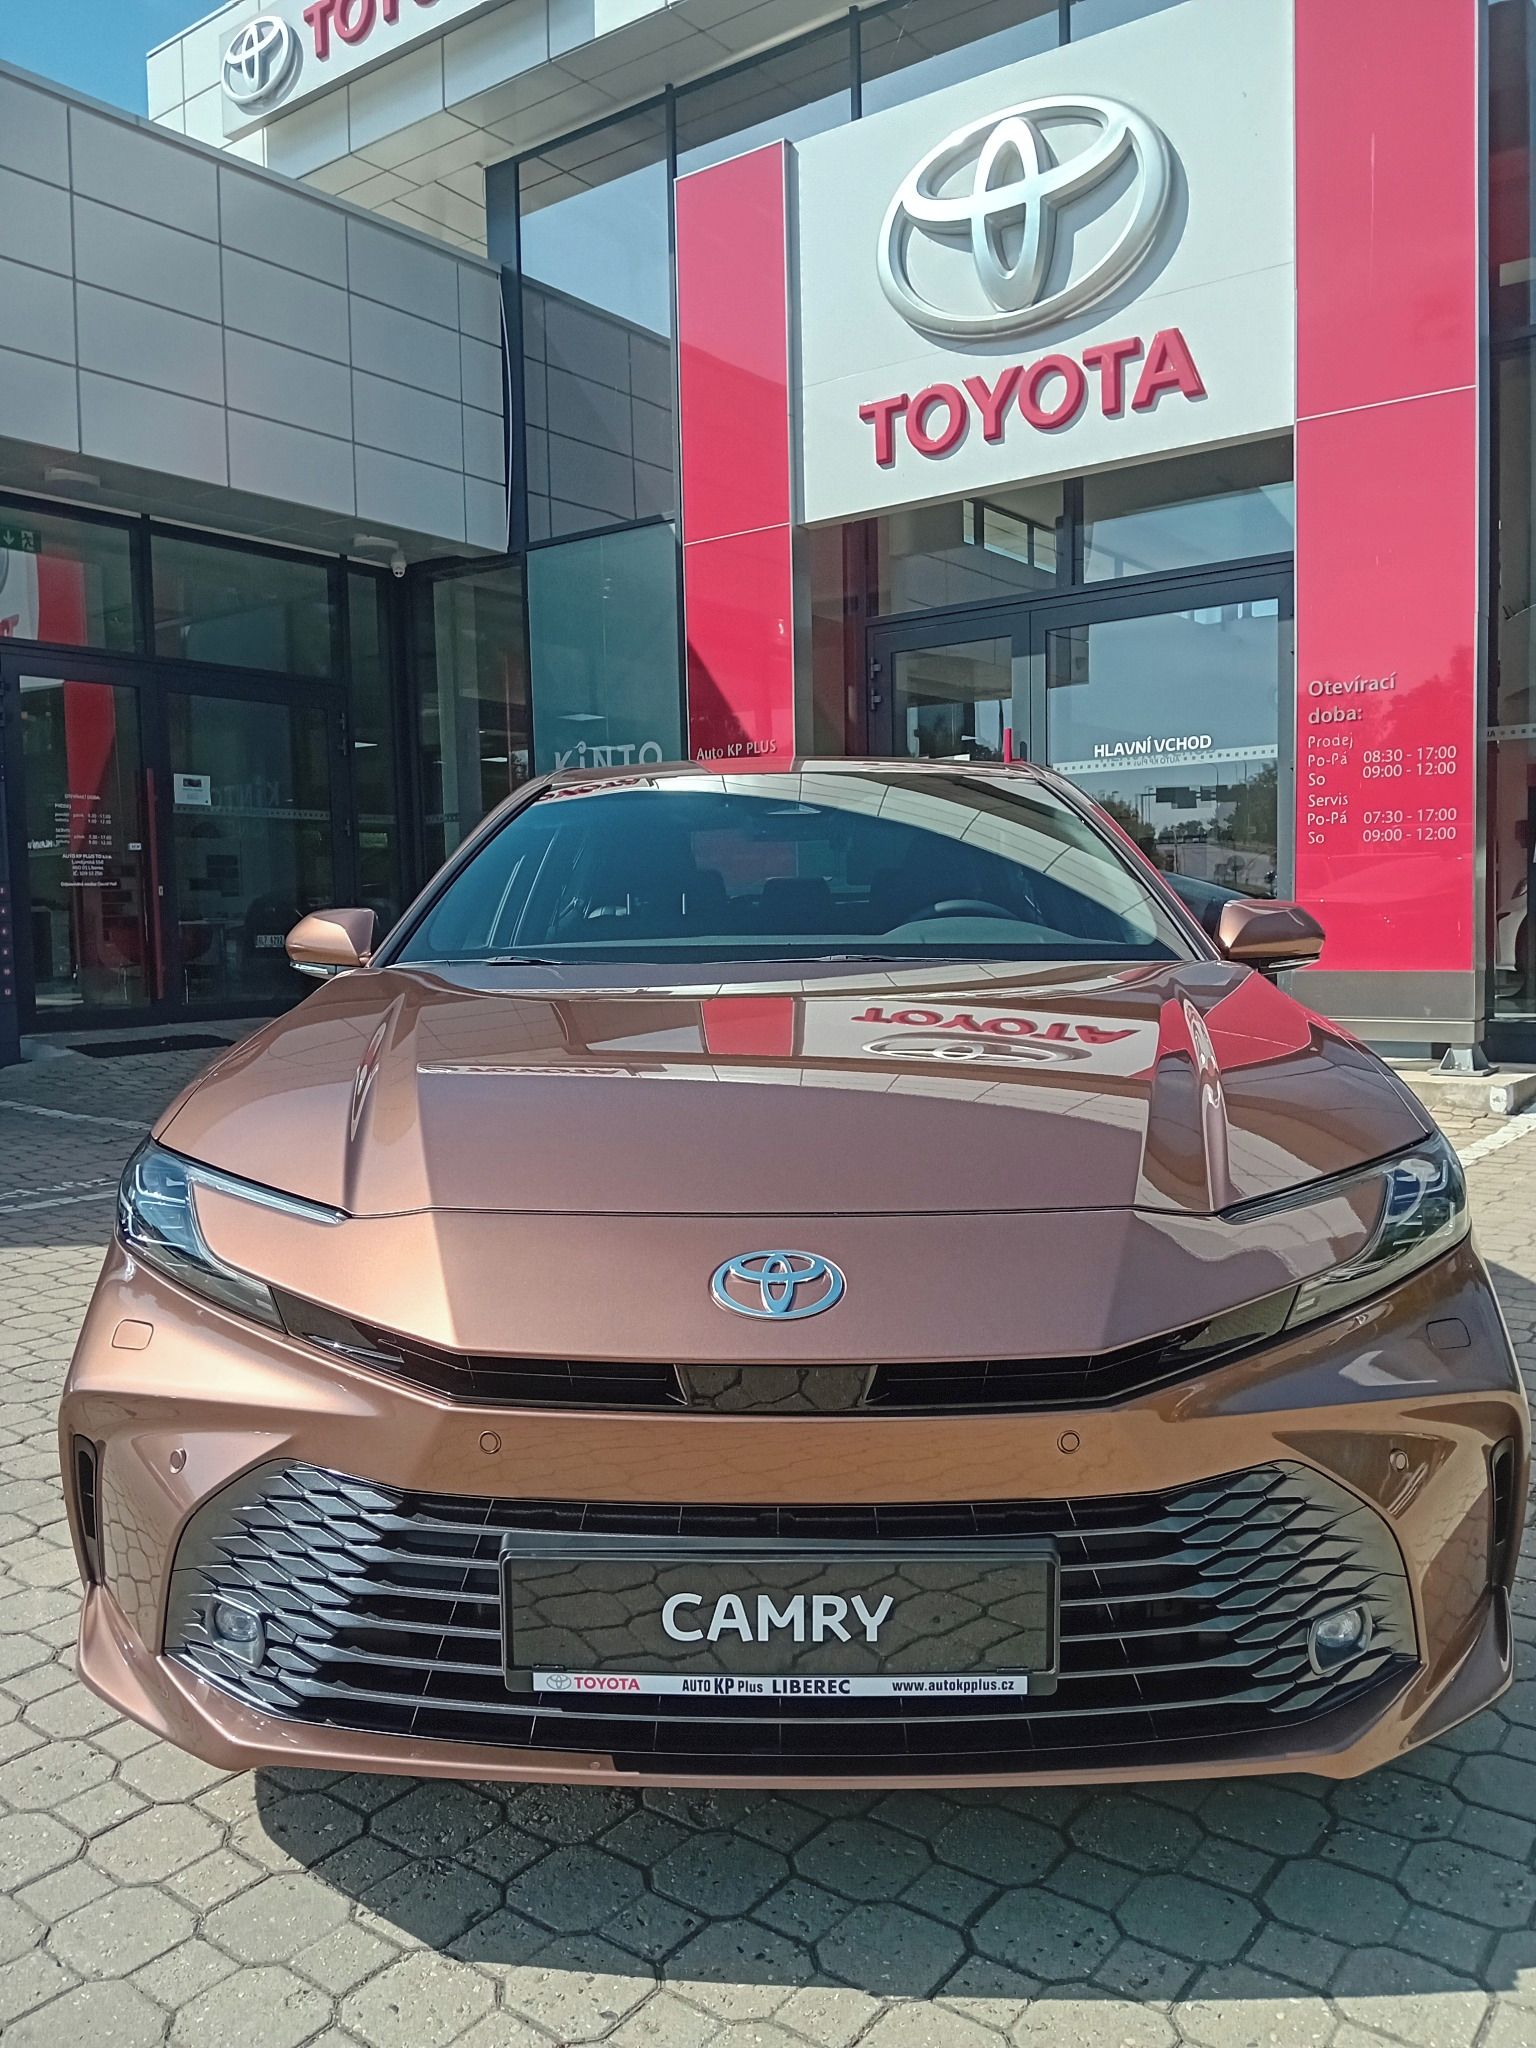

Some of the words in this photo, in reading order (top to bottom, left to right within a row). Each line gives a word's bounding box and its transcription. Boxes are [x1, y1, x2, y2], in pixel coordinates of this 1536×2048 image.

[858, 327, 1207, 467] TOYOTA
[1308, 672, 1397, 696] Otevírací
[1308, 706, 1363, 724] doba:
[697, 747, 723, 760] Auto
[727, 743, 742, 757] KP
[746, 739, 777, 754] PLUS
[1094, 736, 1151, 757] HLAVNÍ
[1154, 735, 1212, 752] VCHOD
[1308, 733, 1353, 748] Prodej
[1308, 750, 1348, 767] Po-Pá
[1363, 750, 1403, 764] 08:30
[1417, 745, 1457, 760] 17:00
[1308, 773, 1326, 786] So
[1362, 764, 1402, 778] 09:00
[1416, 761, 1456, 776] 12:00
[1308, 793, 1348, 807] Servis
[1307, 811, 1347, 826] Po-Pá
[1363, 810, 1403, 824] 07:30
[1417, 807, 1457, 821] 17:00
[1308, 831, 1325, 845] So
[1362, 828, 1402, 842] 09:00
[1416, 827, 1456, 841] 12:00
[661, 1592, 895, 1643] CAMRY
[574, 1677, 640, 1691] TOYOTA
[682, 1679, 710, 1692] AUTO
[714, 1677, 734, 1694] KP
[738, 1680, 763, 1693] Plus
[772, 1679, 850, 1694] LIBEREC
[892, 1679, 1015, 1694] www.autokpplus.cz
